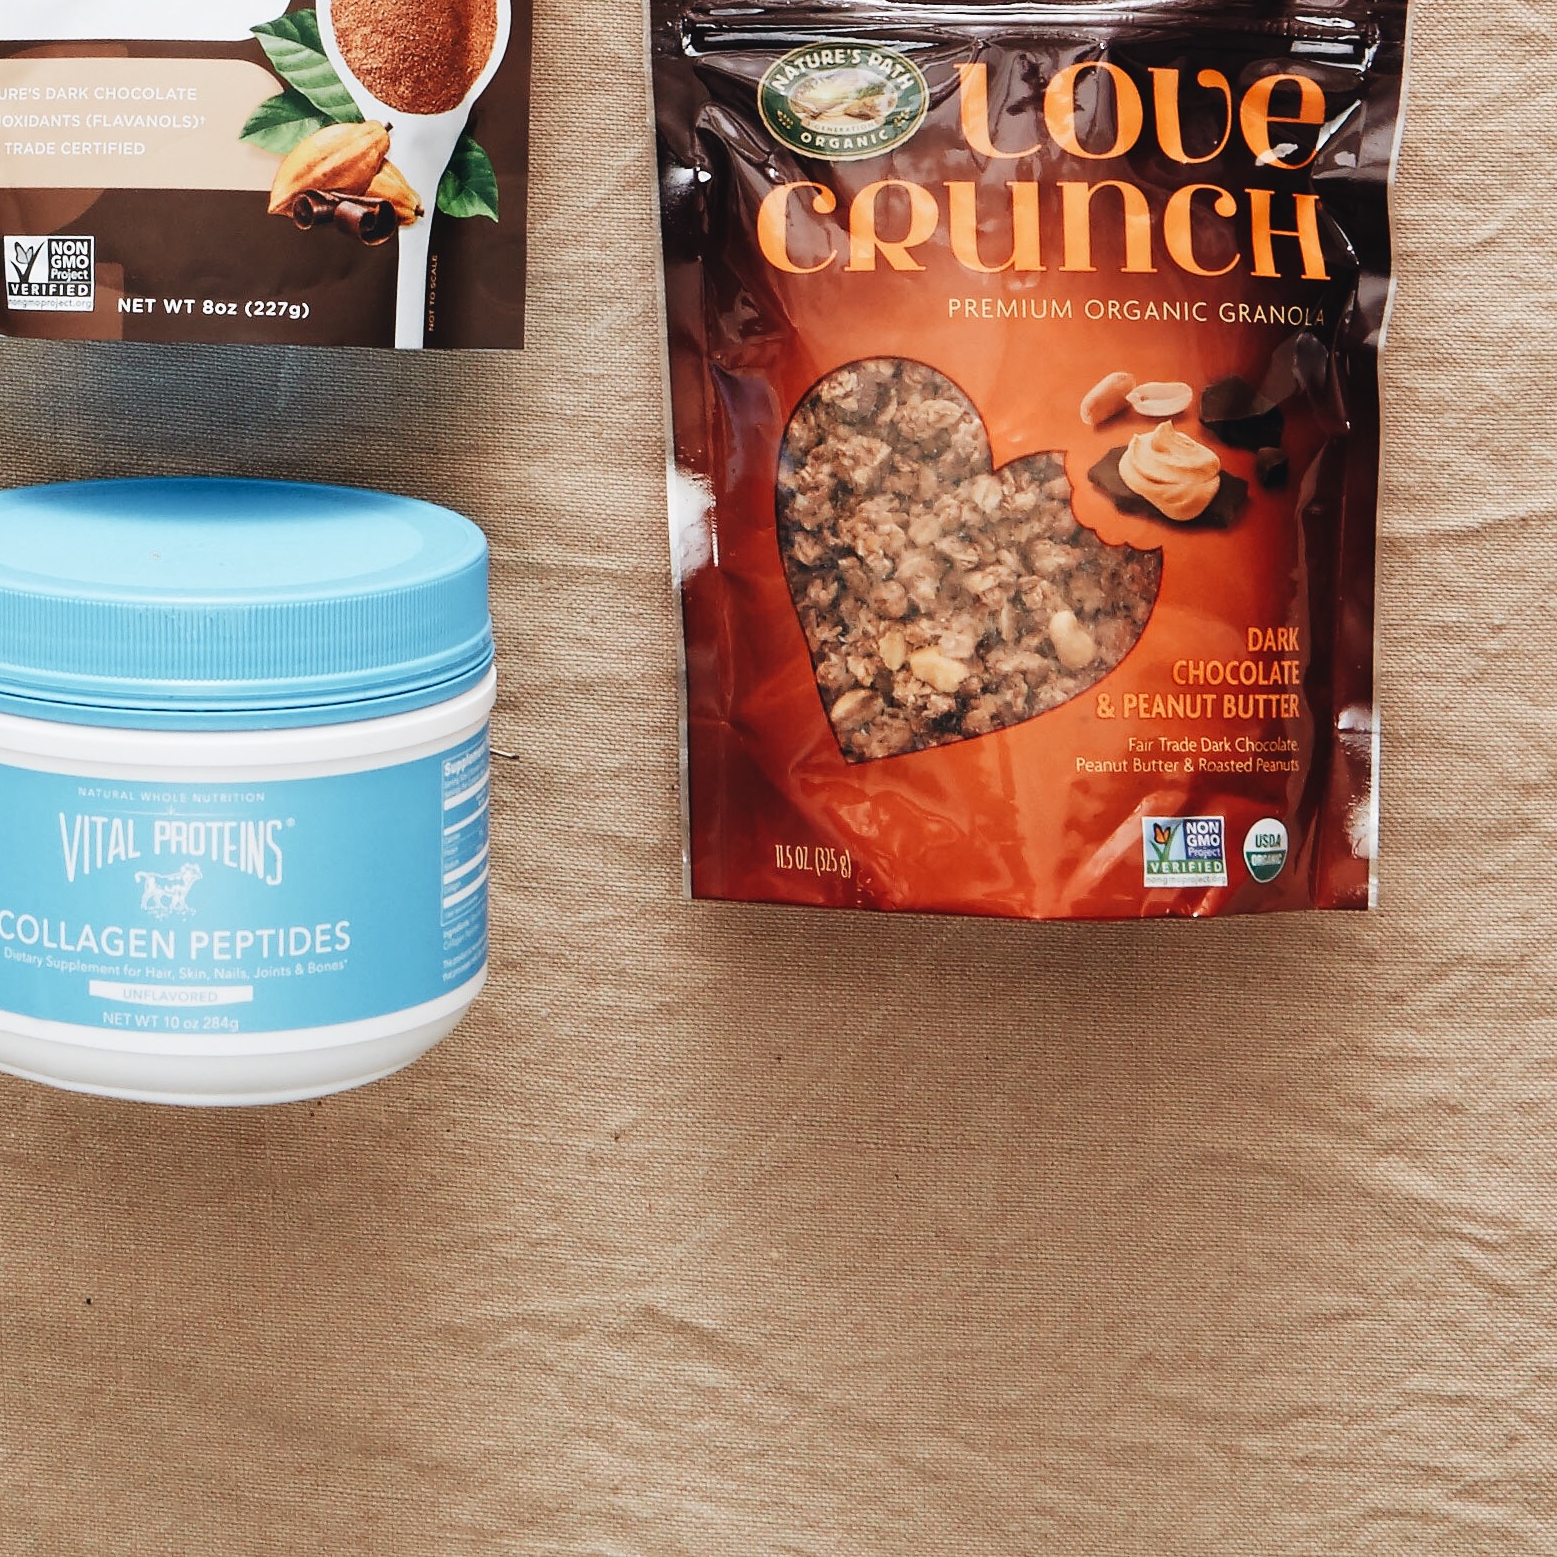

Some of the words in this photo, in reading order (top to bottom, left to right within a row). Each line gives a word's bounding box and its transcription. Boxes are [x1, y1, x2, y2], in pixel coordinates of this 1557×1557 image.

[771, 49, 862, 92] NATURE'S
[868, 52, 915, 90] PATH
[45, 86, 88, 100] DARK
[93, 87, 197, 101] CHOCOLATE
[801, 129, 889, 149] ORGANIC
[4, 142, 56, 155] TRADE
[60, 141, 146, 156] CERTIFIED
[51, 241, 89, 255] NON
[51, 256, 89, 269] GMO
[11, 284, 89, 296] VERIFIED
[117, 298, 156, 313] NET
[163, 299, 196, 314] WT
[202, 299, 237, 315] 8oz
[244, 300, 310, 320] (227g)
[948, 298, 1073, 319] PREMIUM
[1084, 299, 1208, 322] ORGANIC
[1218, 302, 1325, 328] GRANOLA
[1247, 627, 1299, 652] DARK
[1172, 660, 1300, 685] CHOCOLATE
[1097, 693, 1115, 719] &
[1123, 693, 1217, 719] PEANUT
[1223, 694, 1300, 718] BUTTER
[1128, 737, 1153, 752] Fair
[1159, 737, 1197, 752] Trade
[1201, 737, 1231, 752] Dark
[1076, 757, 1128, 773] Peanut
[1133, 758, 1179, 773] Butter
[1183, 758, 1194, 773] &
[1199, 758, 1253, 773] Roasted
[1256, 758, 1300, 773] Peanuts
[78, 787, 134, 801] NATURAL
[141, 791, 186, 803] WHOLE
[193, 792, 265, 803] NUTRITION
[1187, 821, 1219, 834] NON
[59, 811, 140, 883] VITAL
[1187, 834, 1220, 846] GMO
[1150, 861, 1223, 873] VERIFIED
[190, 920, 351, 960] PEPTIDES
[4, 947, 42, 968] Dietary
[46, 954, 121, 976] Supplement
[123, 963, 142, 976] for
[146, 966, 175, 980] Hair,
[253, 965, 291, 979] Joints
[123, 989, 218, 1003] UNFLAVORED
[103, 1012, 132, 1026] NET
[135, 1014, 160, 1028] WT
[163, 1015, 180, 1029] 10
[183, 1018, 199, 1030] oz
[202, 1016, 239, 1033] 284g
